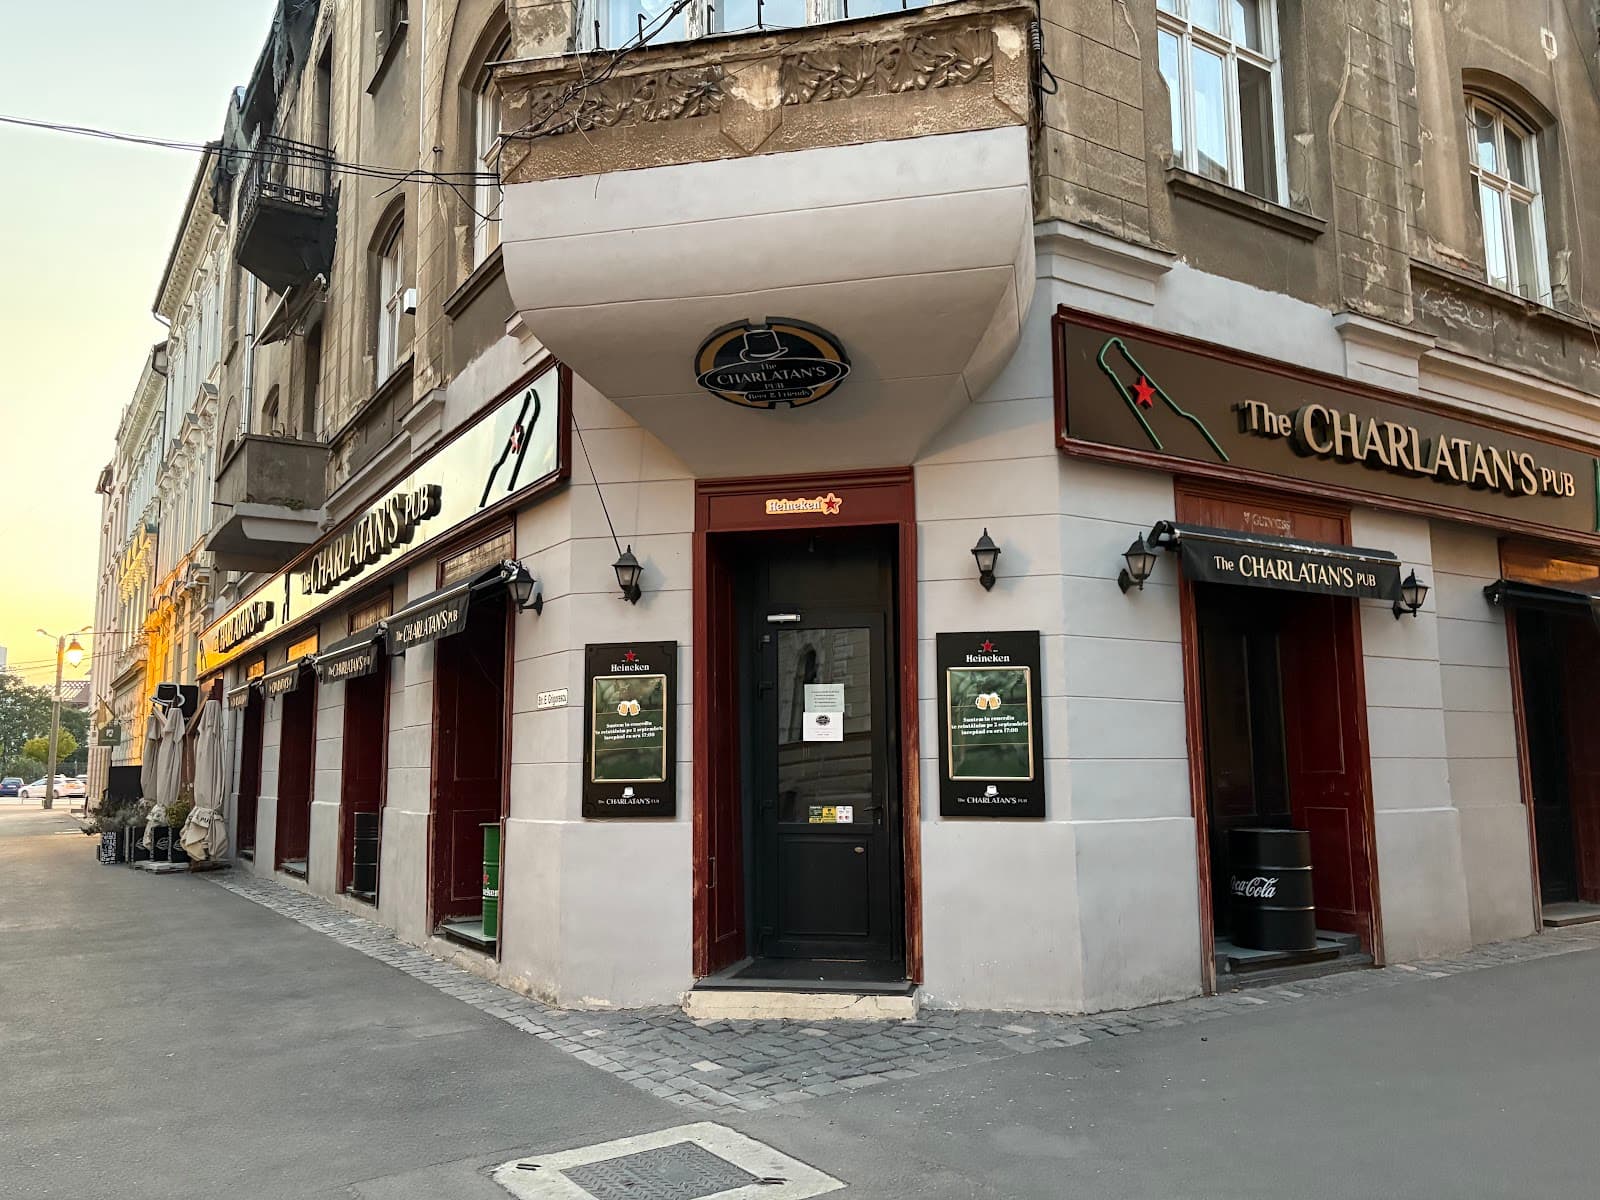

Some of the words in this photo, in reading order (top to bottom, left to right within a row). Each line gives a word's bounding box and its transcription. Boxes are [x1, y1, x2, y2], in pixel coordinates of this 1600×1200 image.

[717, 366, 826, 385] CHARLATAN'S
[1244, 400, 1292, 437] The
[1302, 403, 1538, 496] CHARLATAN'S
[1540, 466, 1575, 497] PUB
[768, 500, 822, 512] Heineken
[311, 493, 400, 594] CHARLATAN'S
[404, 484, 432, 526] PUB
[1213, 555, 1235, 571] The
[1239, 554, 1354, 588] CHARLATAN'S
[1357, 572, 1376, 587] PUB
[395, 631, 403, 642] The
[403, 610, 448, 642] CHARLATAN'S
[333, 655, 364, 677] CHARLATAN'S
[610, 664, 650, 672] Heineken
[966, 654, 1010, 663] Heineken
[998, 720, 1028, 728] septembrie
[966, 796, 1017, 804] CHARLATAN'S
